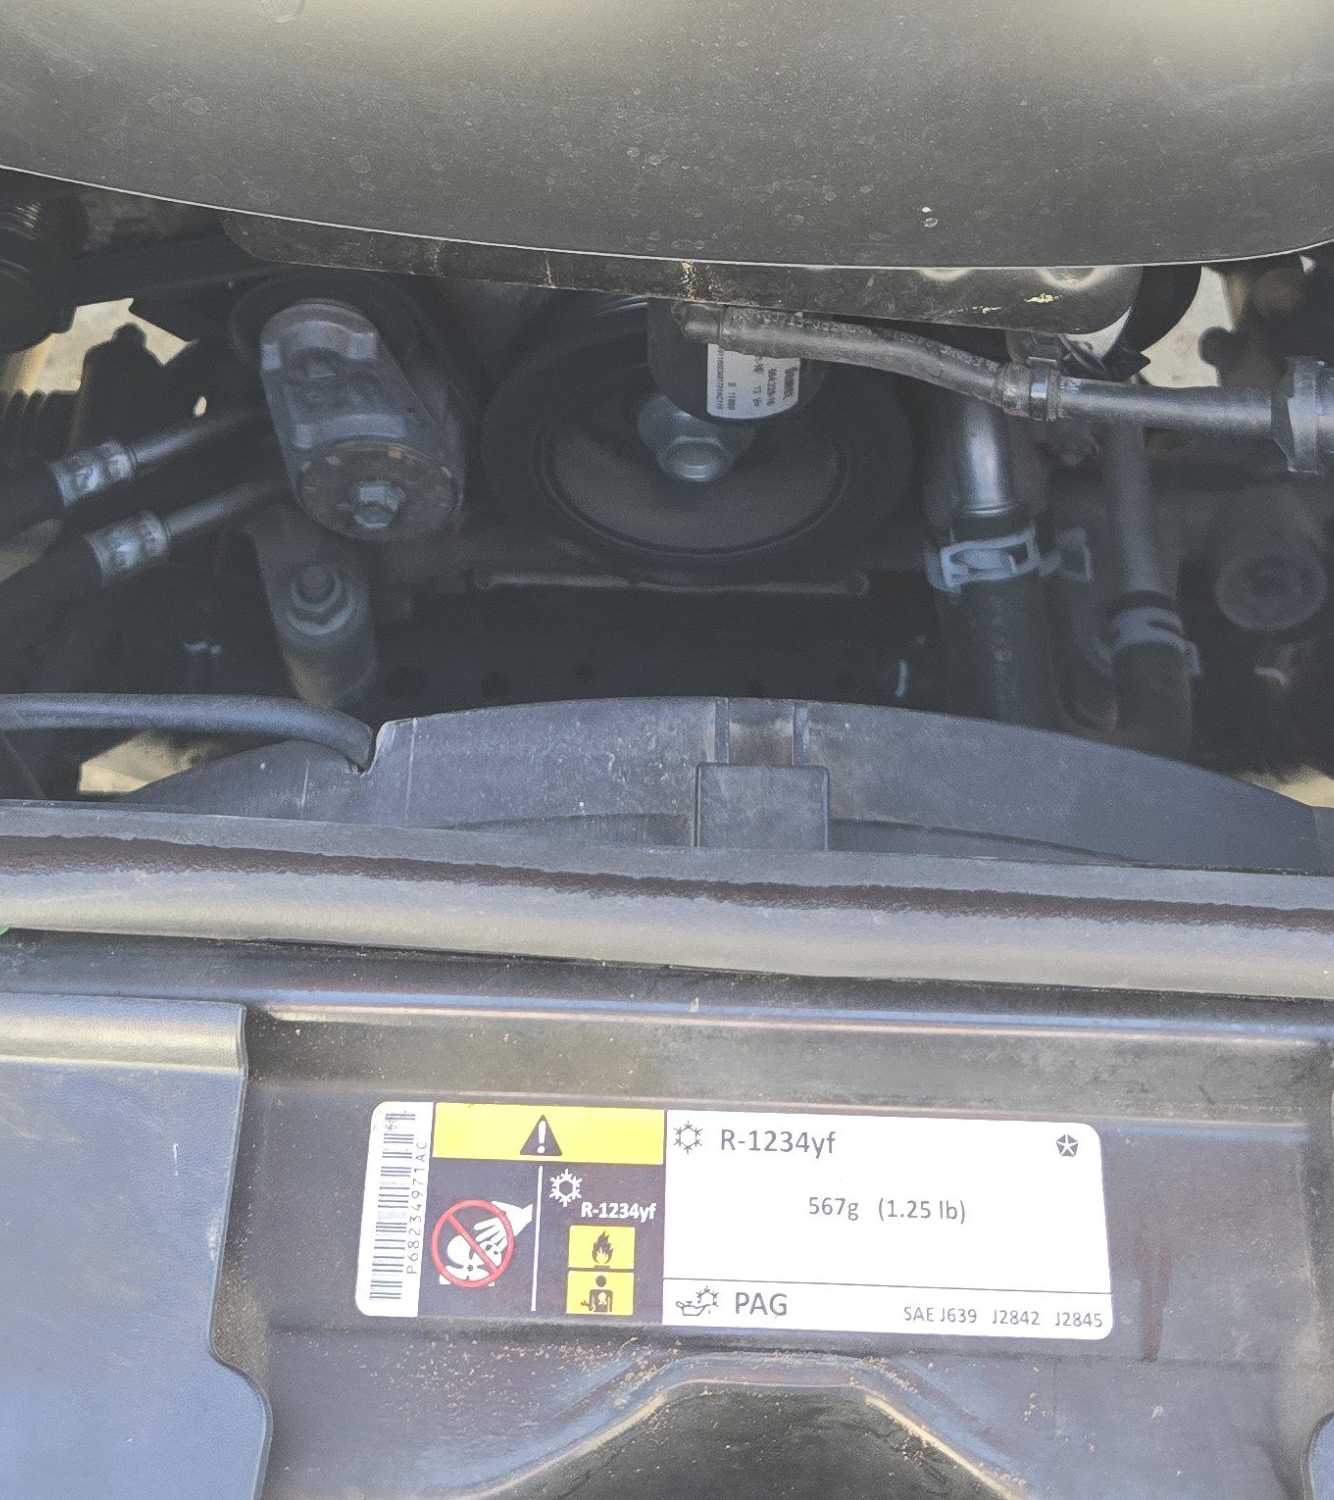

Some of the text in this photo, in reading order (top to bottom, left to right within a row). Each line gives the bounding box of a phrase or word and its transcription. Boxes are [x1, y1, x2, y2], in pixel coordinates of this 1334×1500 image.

[720, 1129, 836, 1159] R-1234yf
[406, 1141, 428, 1274] P68234971AC
[581, 1203, 657, 1222] R-1234yf
[808, 1196, 966, 1224] 567g (1.25 lb)
[734, 1292, 788, 1317] PAG
[904, 1306, 1103, 1328] SAE J639 J2842 J2845
